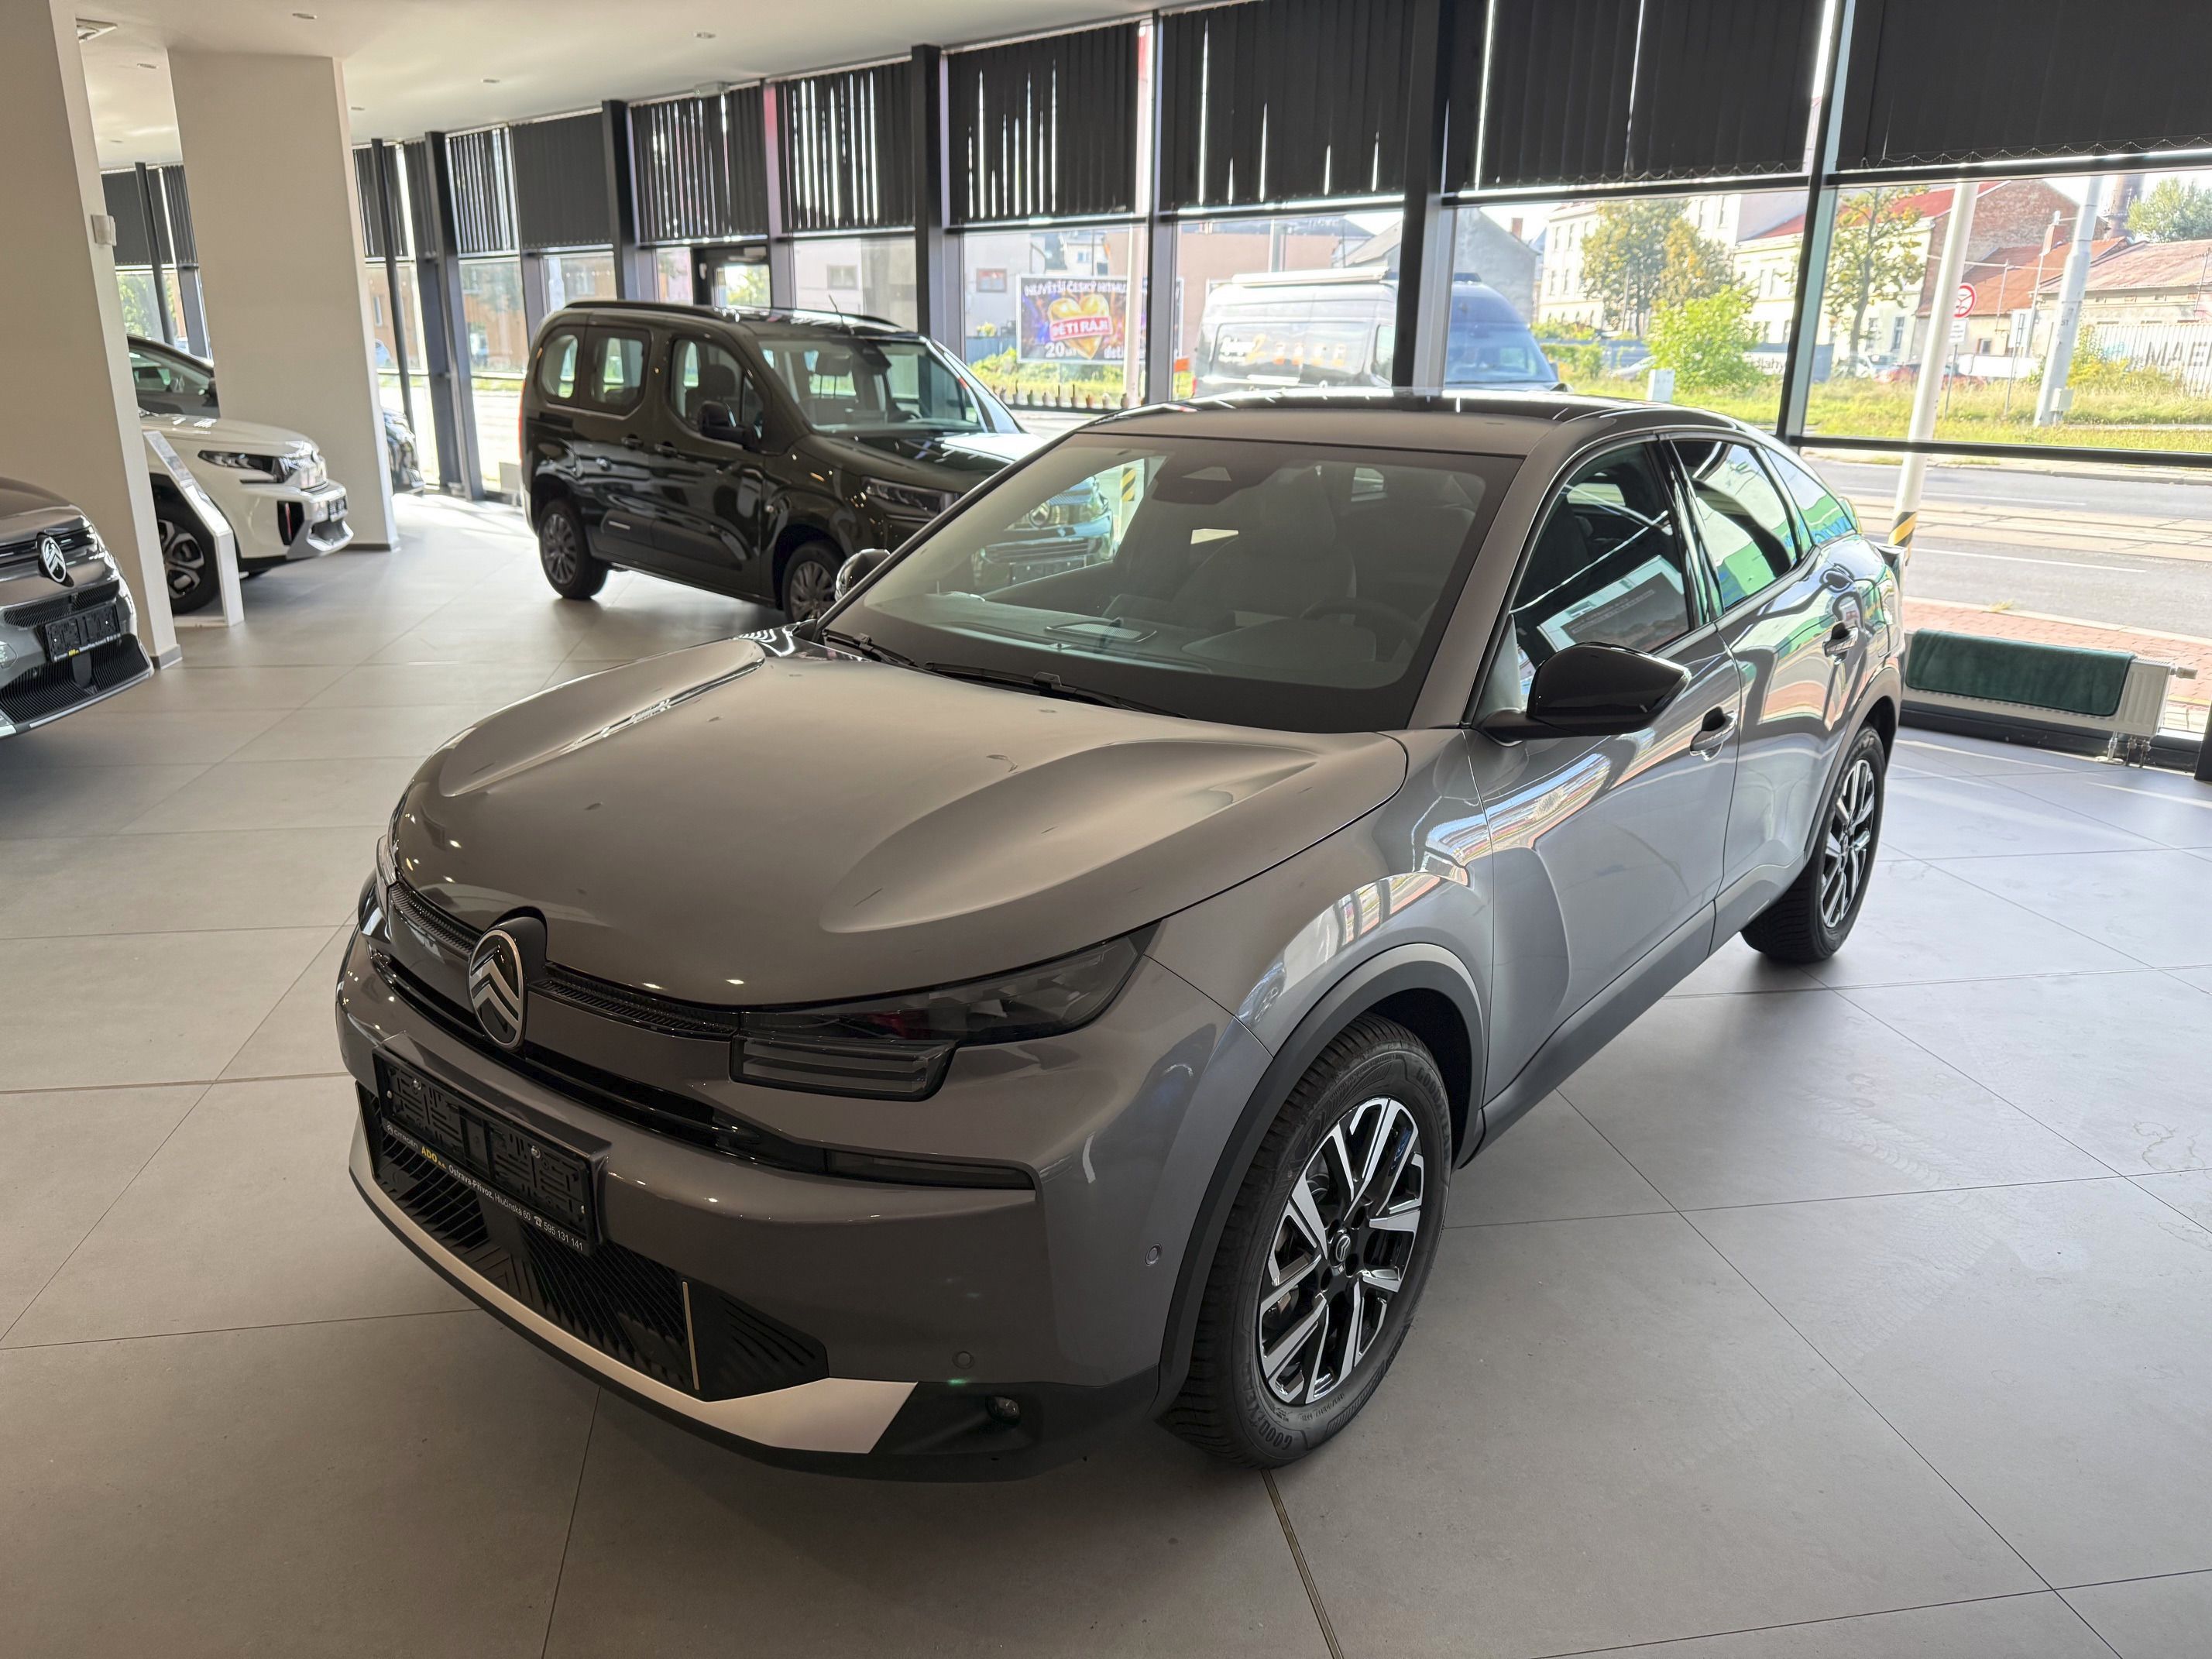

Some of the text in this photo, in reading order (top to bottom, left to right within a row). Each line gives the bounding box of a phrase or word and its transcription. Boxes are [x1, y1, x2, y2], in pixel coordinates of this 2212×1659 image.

[2145, 341, 2212, 367] MAE
[421, 1146, 438, 1163] ADO
[523, 1210, 531, 1221] 60
[544, 1221, 556, 1236] 595
[558, 1230, 569, 1243] 131
[572, 1238, 582, 1251] 141
